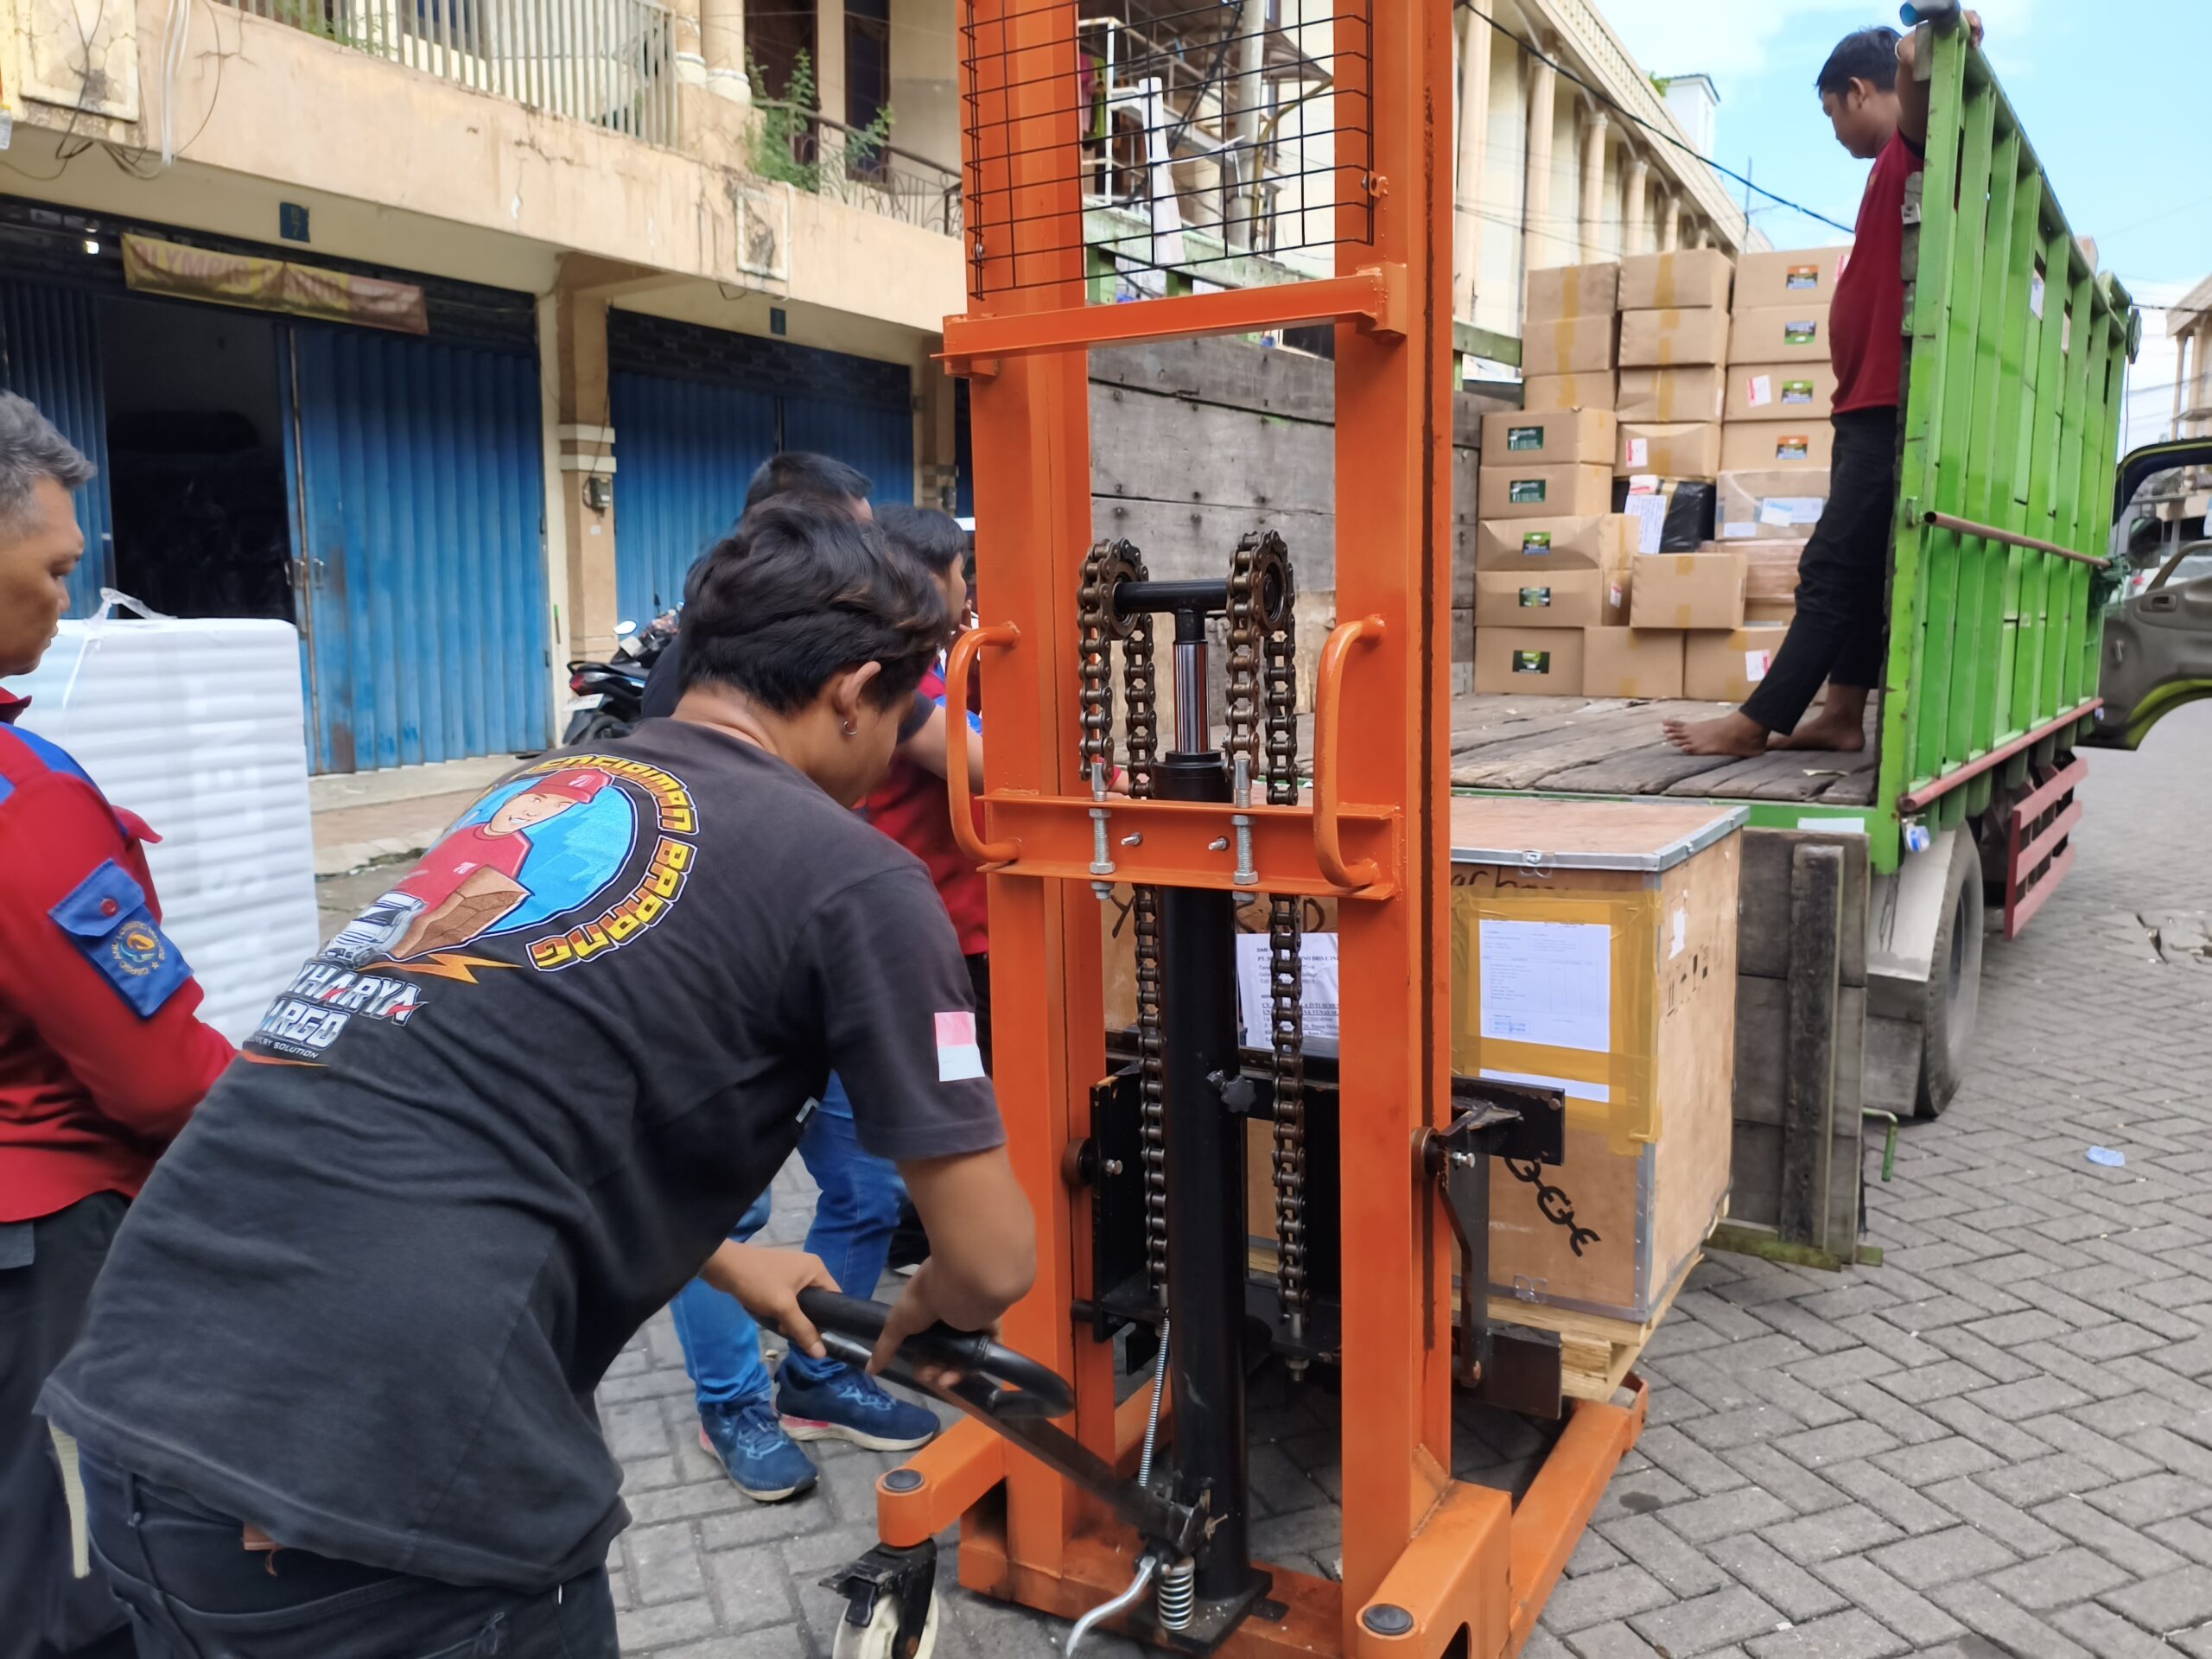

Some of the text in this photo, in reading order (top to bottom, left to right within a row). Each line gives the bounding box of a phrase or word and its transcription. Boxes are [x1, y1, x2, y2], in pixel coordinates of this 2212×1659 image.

[518, 754, 695, 832] ENGIRIMAN
[529, 837, 693, 969] BARANG
[273, 1041, 319, 1059] SOLUTION
